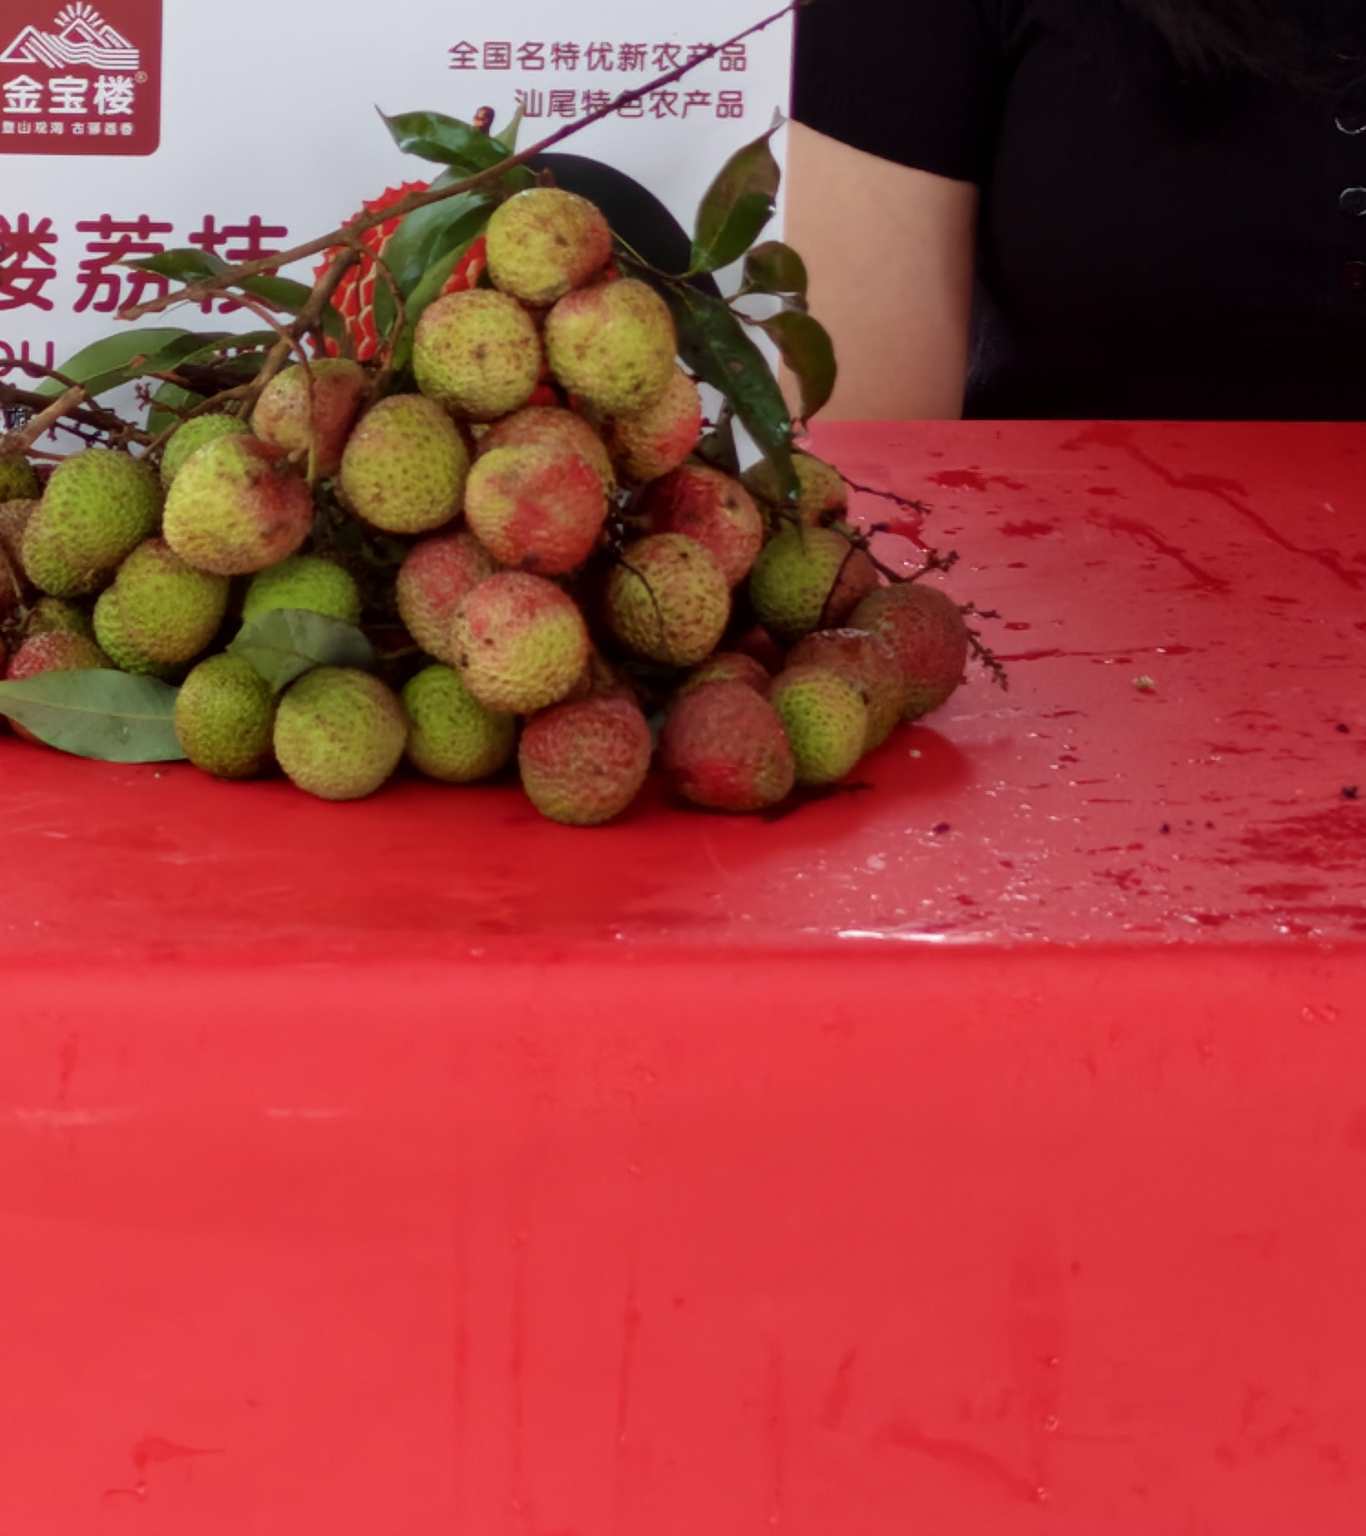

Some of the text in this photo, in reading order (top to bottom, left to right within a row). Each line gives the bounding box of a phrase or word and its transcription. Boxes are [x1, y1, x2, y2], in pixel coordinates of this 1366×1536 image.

[448, 40, 747, 72] 全国名特优新农产品
[2, 74, 134, 116] 金宝楼
[514, 88, 744, 119] 汕尾特色农产品
